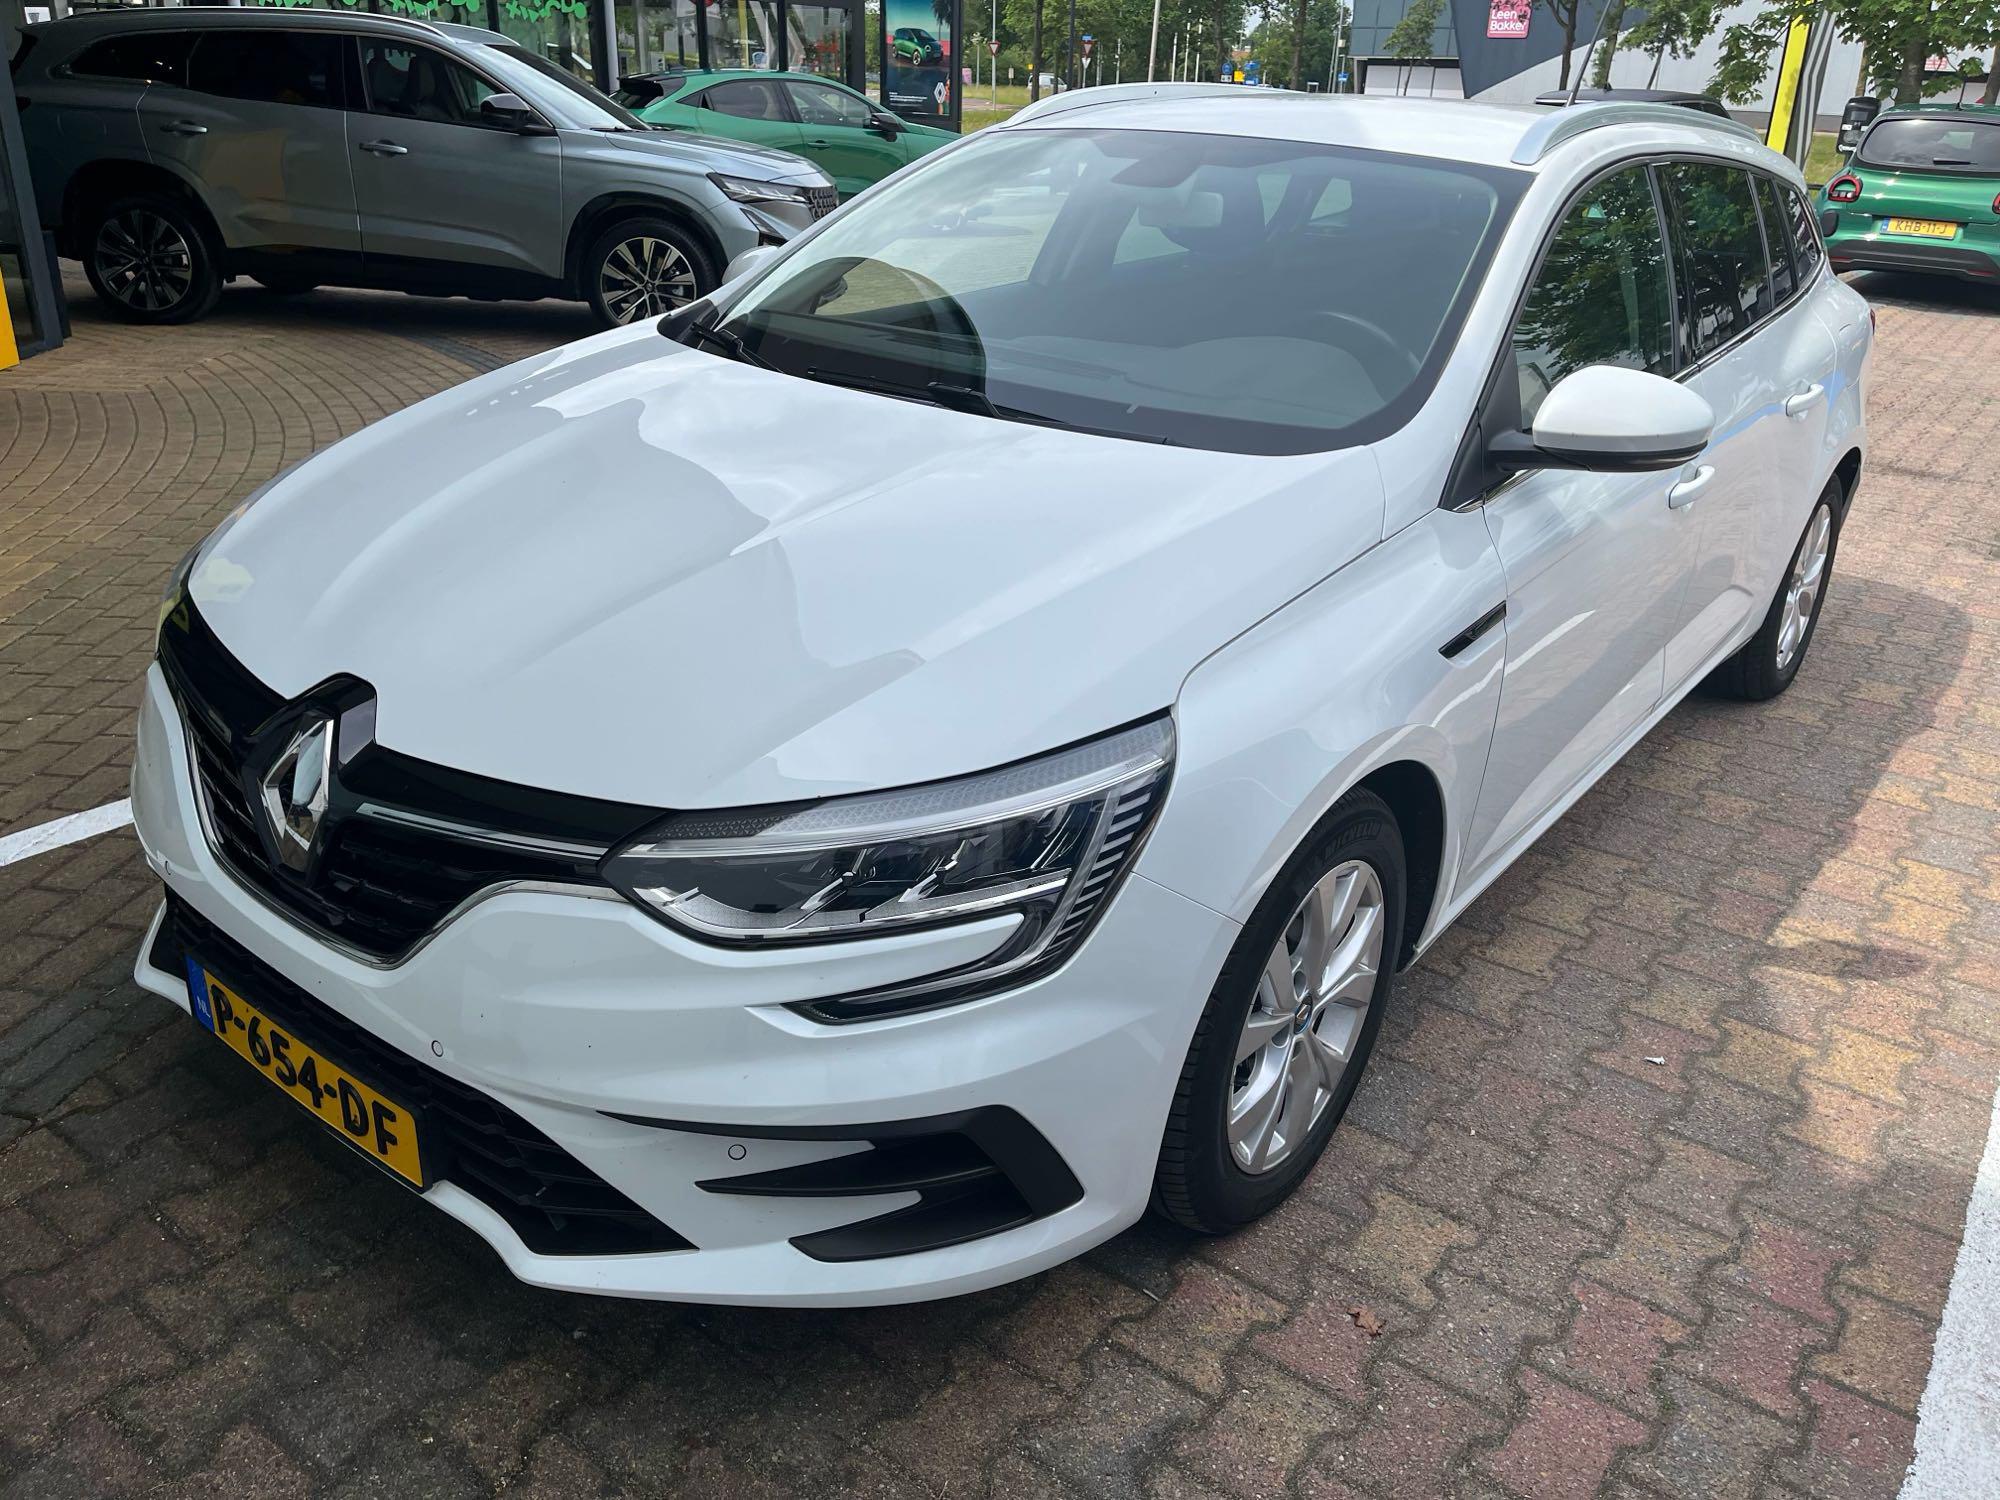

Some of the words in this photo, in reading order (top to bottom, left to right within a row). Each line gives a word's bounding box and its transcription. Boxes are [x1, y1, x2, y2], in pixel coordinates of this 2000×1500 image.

[1491, 10, 1518, 20] Leen
[1490, 20, 1526, 31] Bakker
[1894, 219, 1948, 234] KHB-11-J
[210, 983, 399, 1156] P-654-DF
